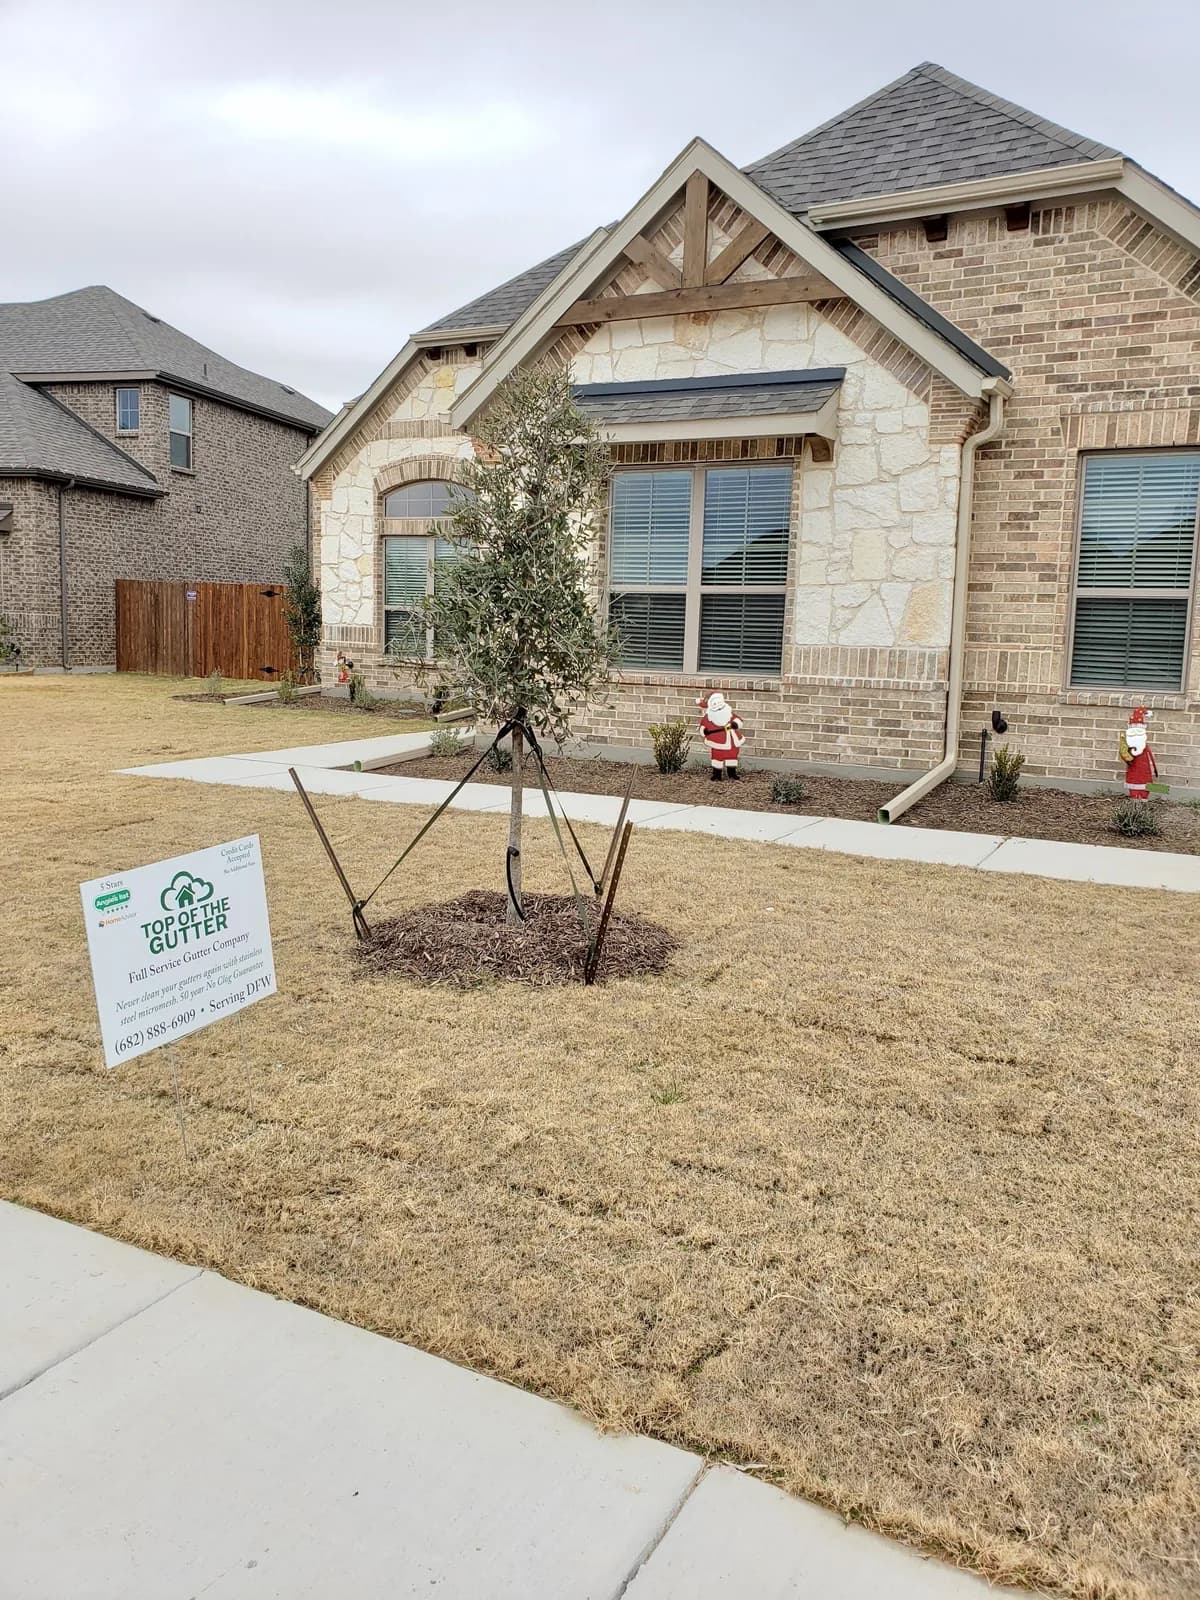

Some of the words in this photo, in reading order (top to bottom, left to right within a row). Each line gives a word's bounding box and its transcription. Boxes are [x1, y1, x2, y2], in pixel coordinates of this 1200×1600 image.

[220, 846, 238, 857] Credit
[238, 841, 254, 852] Cards
[227, 850, 250, 863] Accepted
[106, 880, 124, 890] Stars
[141, 915, 176, 938] TOP
[178, 909, 198, 927] OF
[200, 896, 230, 917] THE
[150, 914, 228, 954] GUTTER
[128, 970, 148, 984] Full
[150, 958, 182, 977] Service
[183, 948, 212, 964] Gutter
[212, 932, 250, 952] Company
[116, 998, 140, 1012] Never
[141, 990, 160, 1004] clean
[161, 983, 178, 996] your
[178, 972, 202, 991] gutters
[203, 965, 222, 979] again
[223, 956, 238, 971] with
[238, 948, 263, 965] stainless
[120, 1012, 138, 1026] steel
[180, 990, 190, 1002] 50
[190, 986, 204, 1000] year
[206, 980, 216, 992] No
[218, 973, 232, 986] Clog
[233, 961, 264, 979] Guarantee
[114, 1031, 144, 1056] (682)
[147, 1008, 196, 1041] 888-6909
[209, 990, 246, 1012] Serving
[246, 974, 272, 996] DFW
